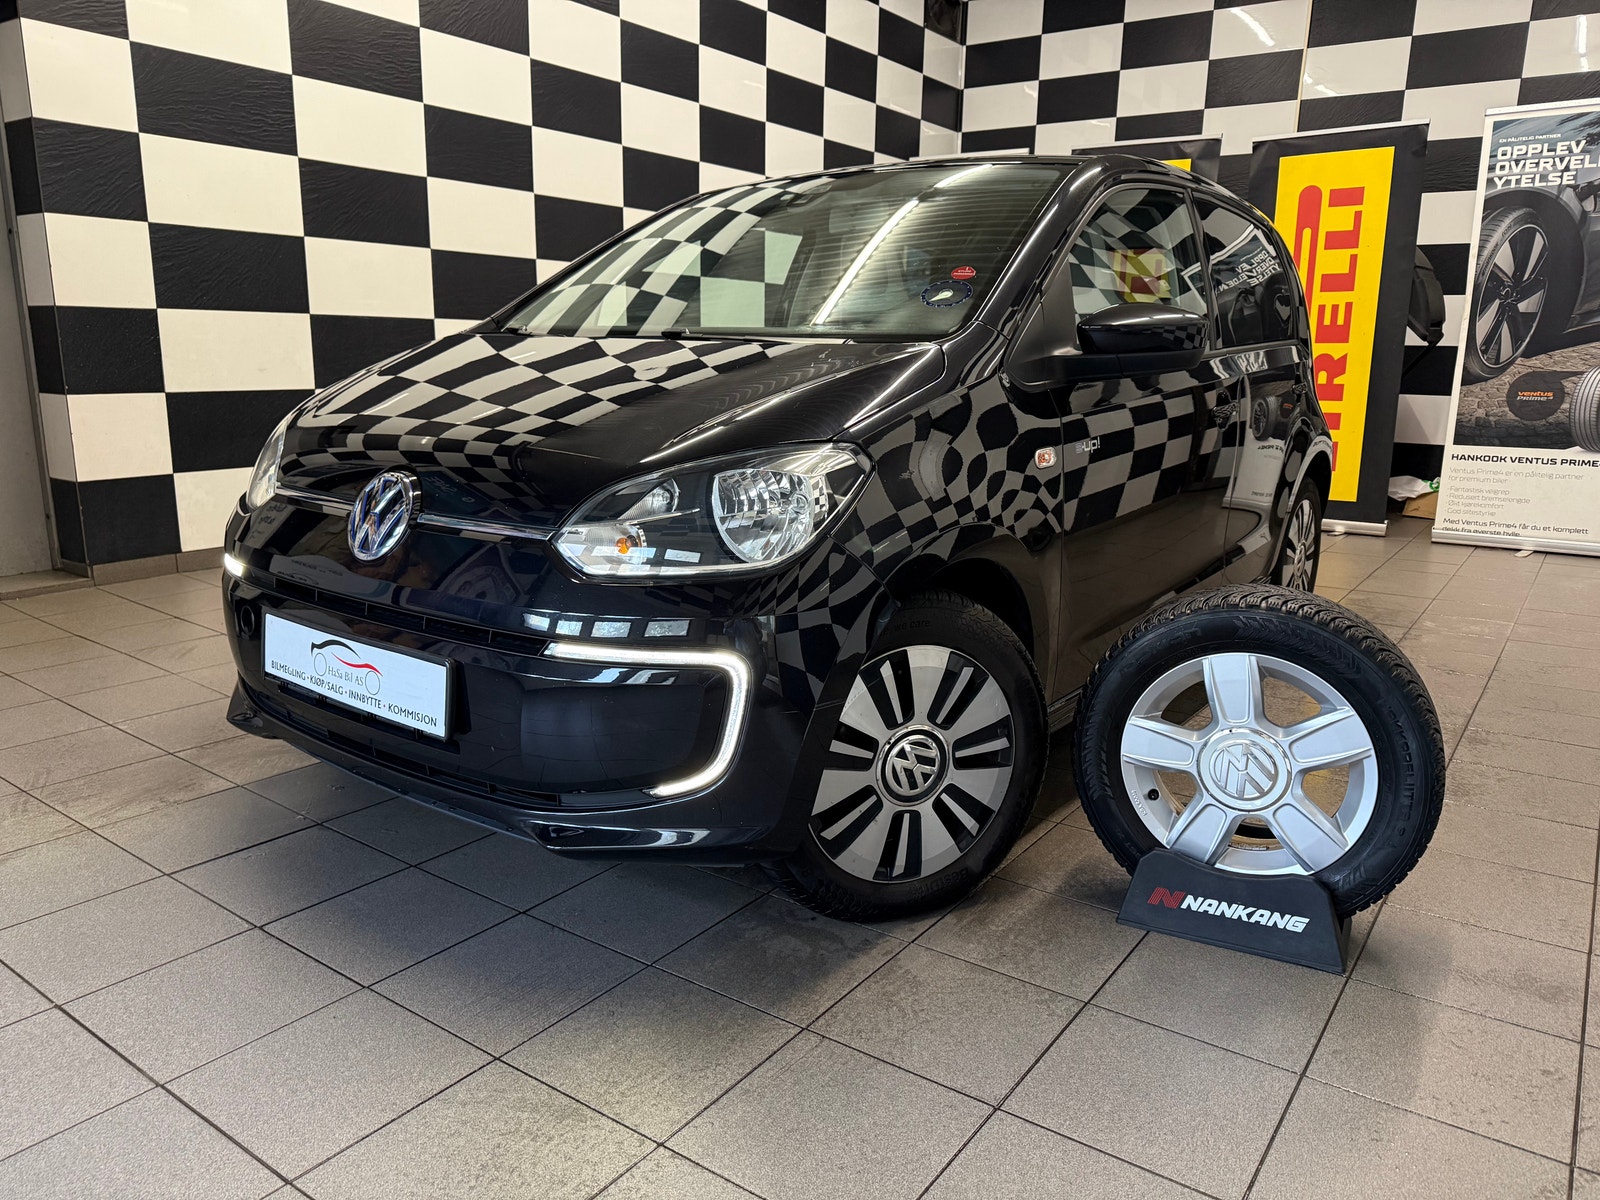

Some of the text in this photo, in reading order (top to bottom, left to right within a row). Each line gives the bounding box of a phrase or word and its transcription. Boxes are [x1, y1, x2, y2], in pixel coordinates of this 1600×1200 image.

[1497, 140, 1586, 160] OPPLEV
[1495, 154, 1600, 175] OVERVEL
[1493, 171, 1577, 189] YTELSE
[1451, 453, 1600, 468] HANKOOK VENTUS PRIME
[1450, 467, 1475, 475] Ventus
[1477, 468, 1503, 476] Prime4
[1449, 492, 1480, 500] Redusert
[1450, 485, 1484, 493] Fantastisk
[1443, 517, 1460, 525] Med
[1461, 519, 1488, 528] Ventus
[1489, 521, 1517, 530] Prime4
[1518, 523, 1530, 531] får
[1552, 526, 1589, 535] komplett
[354, 675, 364, 686] AS
[271, 660, 438, 727] BILMEGLING KJØP/SALG INNBYTTE KOMMISJON
[1181, 894, 1311, 933] NANKANG
